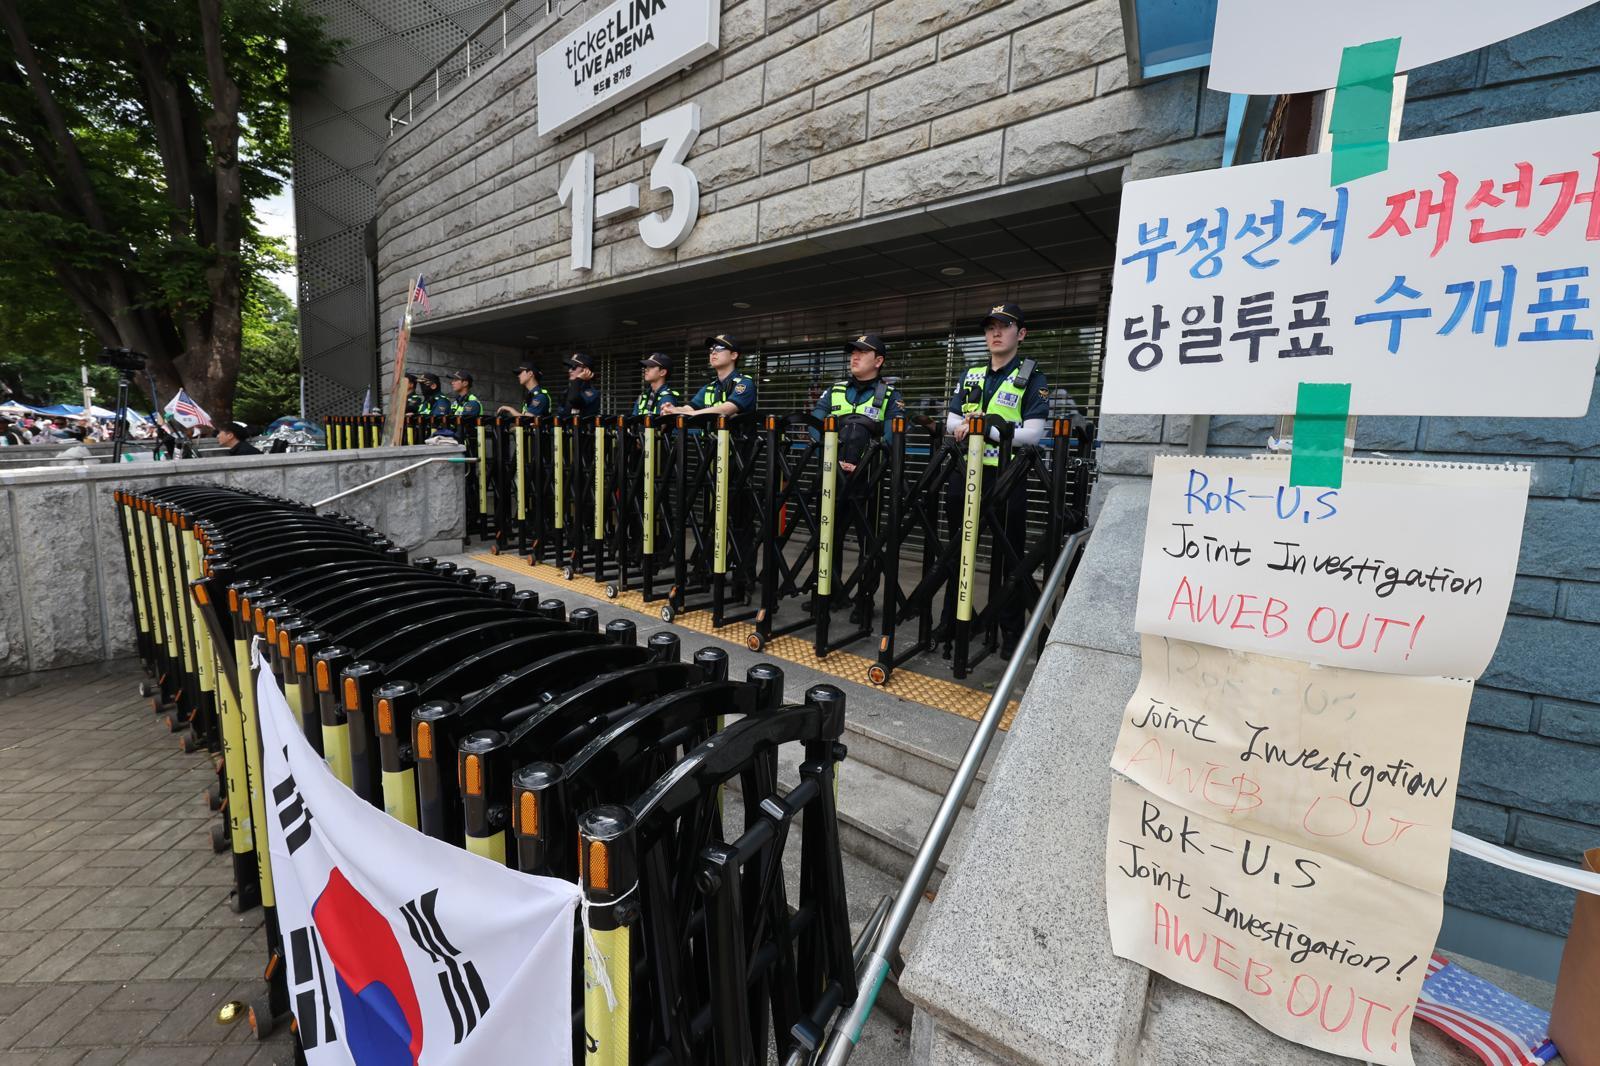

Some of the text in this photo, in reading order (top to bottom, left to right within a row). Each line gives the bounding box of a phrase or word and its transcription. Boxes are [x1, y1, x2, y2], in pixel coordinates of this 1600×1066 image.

[574, 23, 655, 87] LIVE ARENA
[557, 102, 700, 270] 1-3
[1121, 150, 1600, 284] 부정선거 재선거
[1123, 264, 1594, 372] 당일투표 수개표
[959, 469, 977, 602] POLICE LINE
[1162, 523, 1483, 598] Joint Investigation
[1168, 576, 1426, 660] AWEB OUT!
[1123, 738, 1264, 814] AWEB
[1119, 839, 1418, 982] Joint Investigation!
[1154, 902, 1411, 1053] AWEB OUT!
